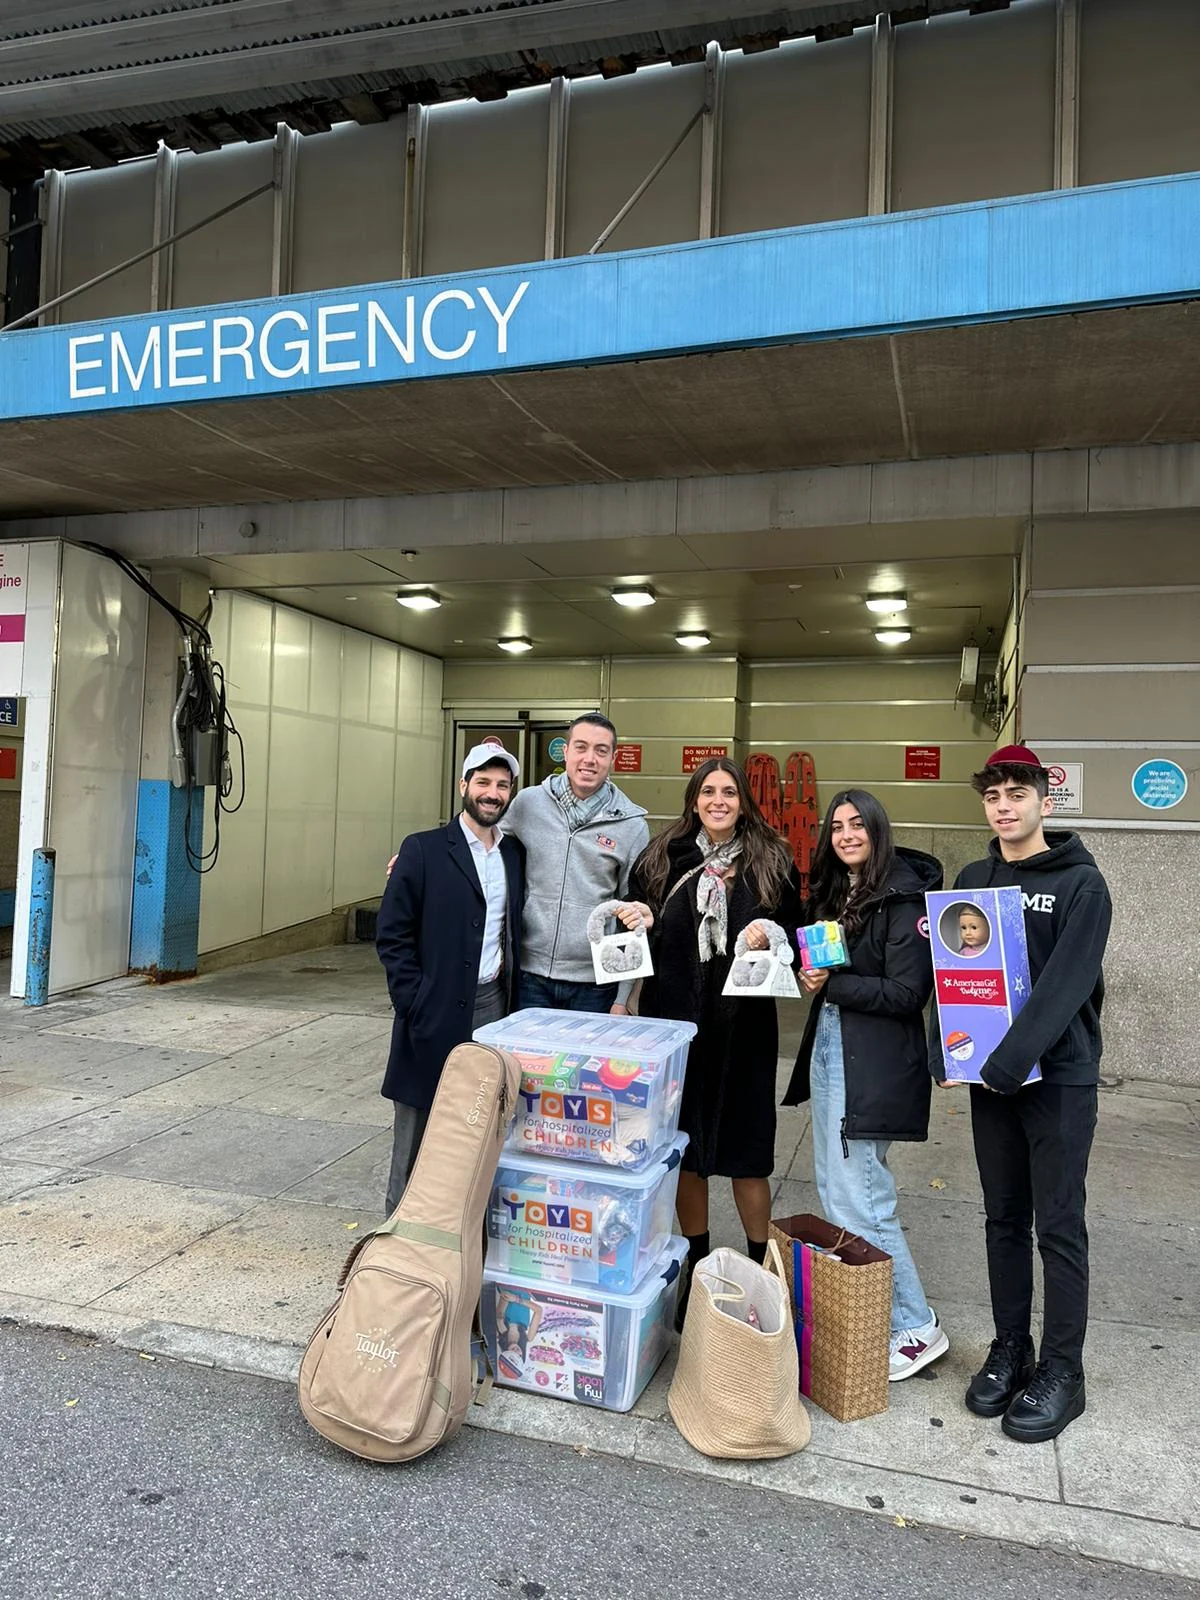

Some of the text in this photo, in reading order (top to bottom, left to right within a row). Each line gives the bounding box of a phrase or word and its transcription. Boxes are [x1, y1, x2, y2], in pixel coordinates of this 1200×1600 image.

[69, 281, 530, 399] EMERGENCY
[953, 978, 985, 987] American
[519, 1087, 613, 1126] TOYS
[524, 1115, 611, 1138] for hospitalized
[523, 1128, 612, 1153] CHILDREN
[502, 1196, 593, 1234] TOYS
[507, 1222, 592, 1245] for hospitalized
[508, 1235, 592, 1258] CHILDREN
[355, 1332, 400, 1365] Taylor
[584, 1383, 603, 1399] my
